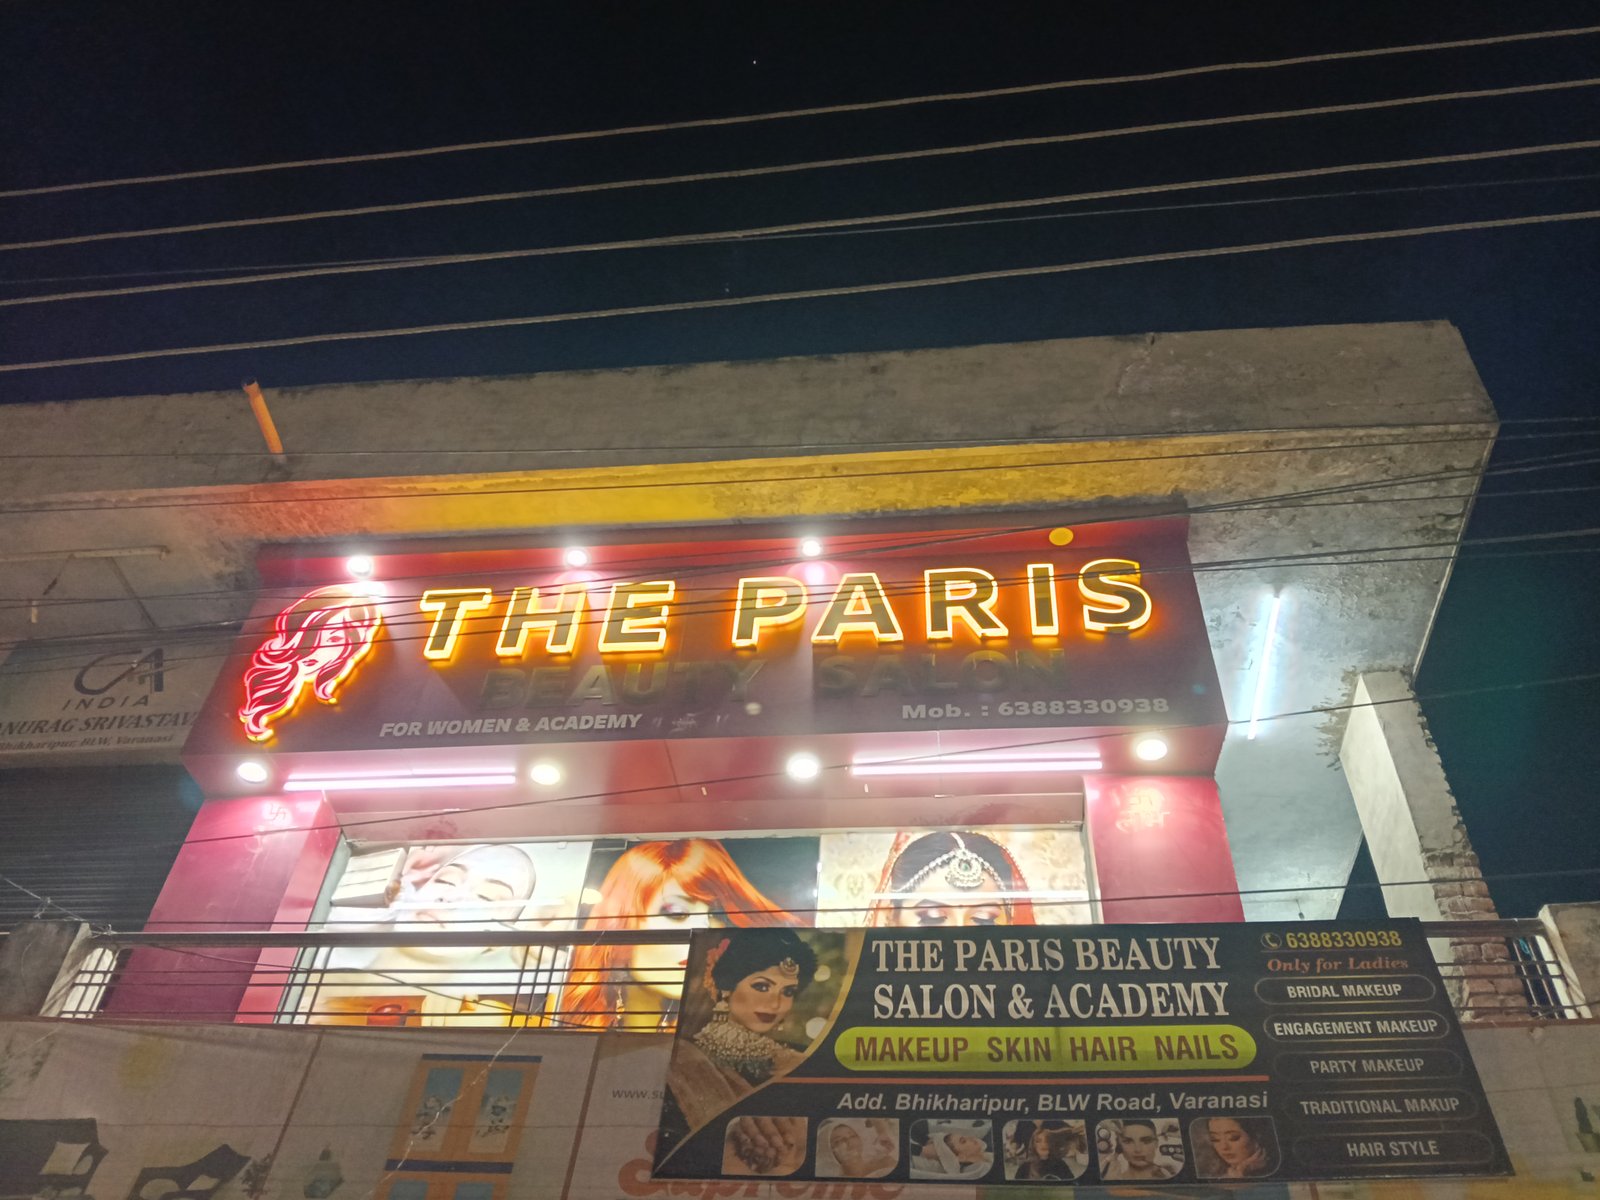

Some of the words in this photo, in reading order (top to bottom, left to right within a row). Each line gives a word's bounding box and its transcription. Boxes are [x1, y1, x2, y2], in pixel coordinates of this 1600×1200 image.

[420, 580, 676, 660] THE
[730, 557, 1153, 650] PARIS
[478, 660, 766, 706] BEAUTY
[817, 647, 1067, 697] SALON
[61, 694, 149, 711] INDIA
[902, 703, 970, 720] Mob.
[998, 697, 1171, 717] 6388330938
[0, 718, 79, 736] NURAG
[79, 711, 197, 731] SRIVASTAV
[379, 721, 422, 737] FOR
[427, 717, 511, 735] WOMEN
[515, 716, 530, 731] &
[534, 713, 643, 731] ACADEMY
[116, 734, 174, 745] Varanasi
[1285, 930, 1402, 949] 6388330938
[872, 940, 944, 972] THE
[954, 938, 1064, 972] PARIS
[1072, 937, 1221, 971] BEAUTY
[1267, 958, 1311, 974] Only
[1315, 957, 1343, 971] for
[1348, 955, 1409, 970] Ladies
[873, 983, 996, 1019] SALON
[1007, 983, 1035, 1019] &
[1044, 982, 1229, 1018] ACADEMY
[1286, 984, 1339, 999] BRIDAL
[1342, 983, 1402, 998] MAKEUP
[1273, 1021, 1372, 1037] ENGAGEMENT
[1377, 1019, 1438, 1034] MAKEUP
[854, 1036, 969, 1063] MAKEUP
[986, 1036, 1051, 1062] SKIN
[1070, 1035, 1138, 1062] HAIR
[1154, 1033, 1240, 1061] NAILS
[1309, 1059, 1357, 1075] PARTY
[1361, 1057, 1425, 1074] MAKEUP
[836, 1092, 888, 1111] Add.
[895, 1092, 1030, 1115] Bhikharipur,
[1037, 1093, 1091, 1112] BLW
[1097, 1092, 1163, 1113] Road,
[1169, 1090, 1269, 1110] Varanasi
[1300, 1099, 1401, 1116] TRADITIONAL
[1404, 1097, 1460, 1113] MAKUP
[1346, 1142, 1385, 1158] HAIR
[1389, 1140, 1440, 1156] STYLE
